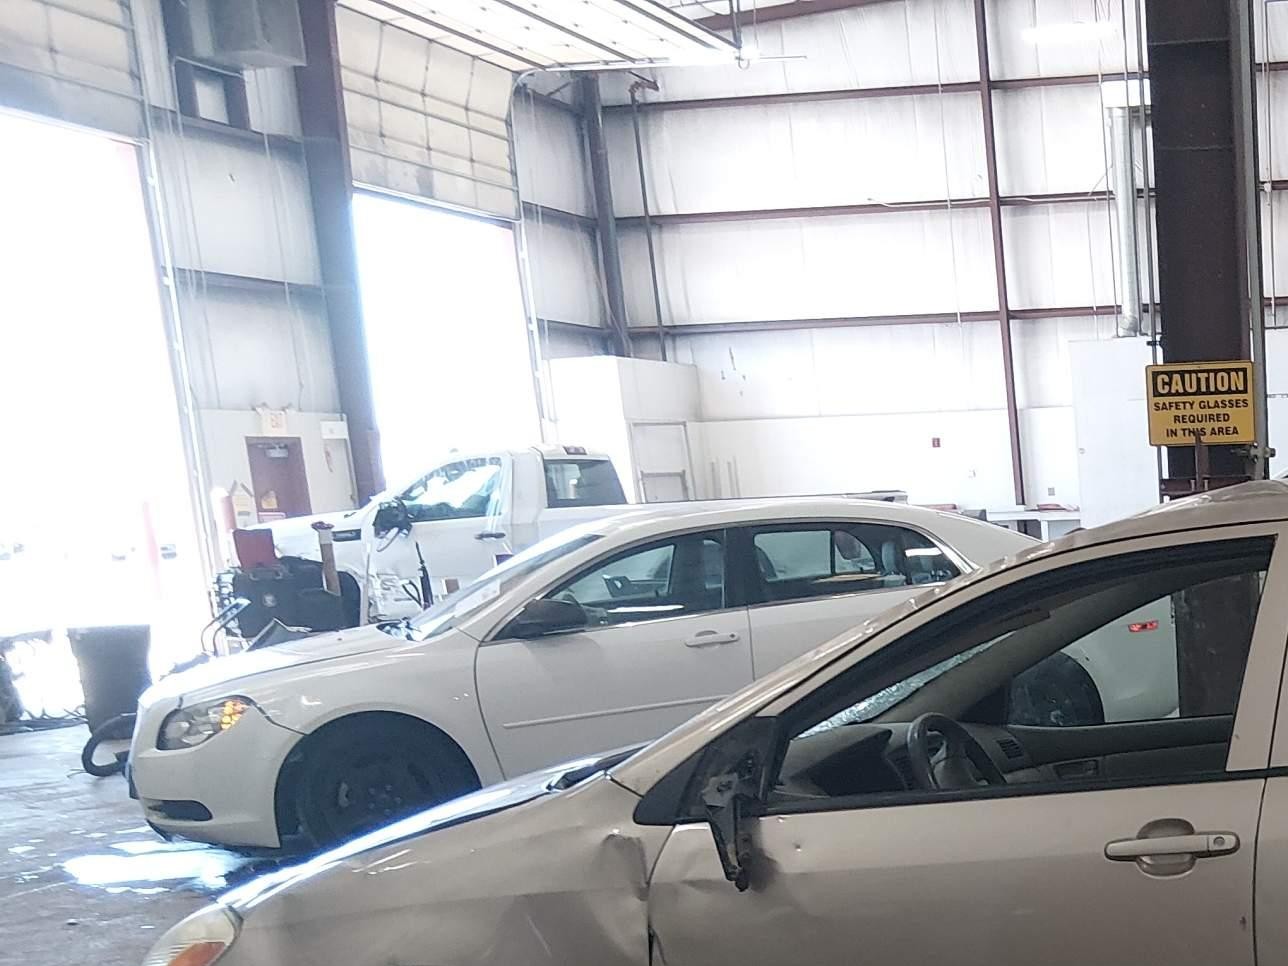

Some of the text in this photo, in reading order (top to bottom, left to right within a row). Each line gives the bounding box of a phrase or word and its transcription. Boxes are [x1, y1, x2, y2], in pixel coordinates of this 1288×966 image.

[1156, 371, 1244, 394] CAUTION
[1153, 399, 1249, 412] SAFETY GLASSES
[1173, 413, 1230, 424] REQUIRED
[1166, 428, 1178, 437] IN
[1210, 426, 1239, 436] AREA
